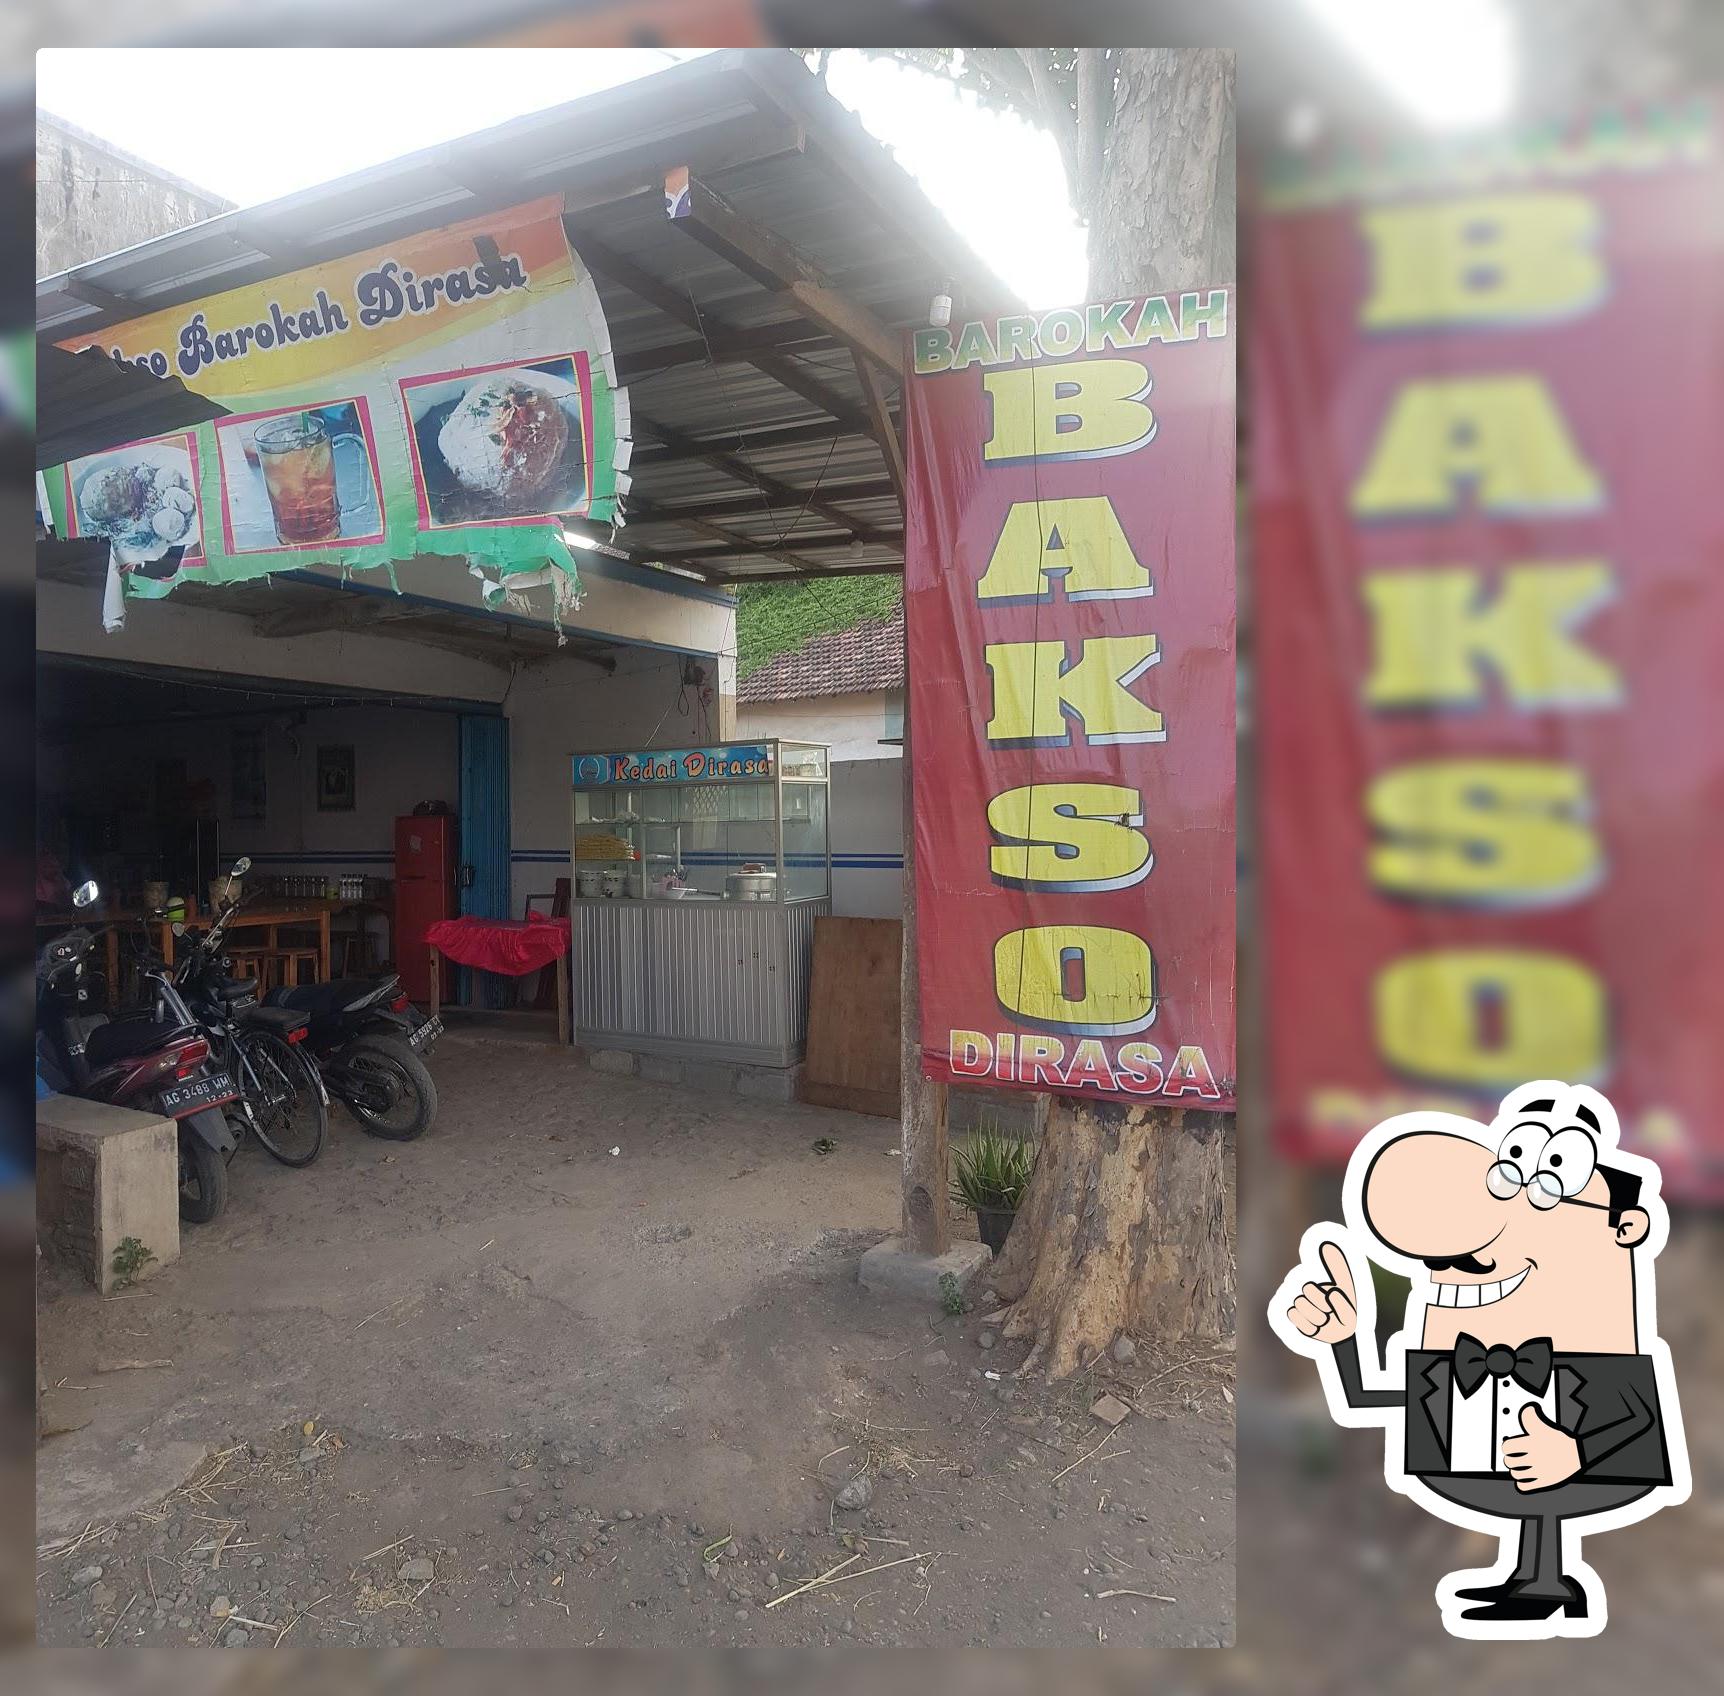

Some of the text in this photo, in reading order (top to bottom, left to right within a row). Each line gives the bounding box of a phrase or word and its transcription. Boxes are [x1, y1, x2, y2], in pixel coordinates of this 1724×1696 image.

[177, 289, 349, 377] Barokah
[355, 255, 528, 328] Dirasa
[914, 290, 1228, 375] BAROKAH
[977, 359, 1167, 1036] BAKSO
[614, 751, 770, 781] Kedai Dirasa
[165, 1092, 180, 1106] AG
[182, 1083, 210, 1099] 3488
[949, 1029, 1221, 1099] DIRASA
